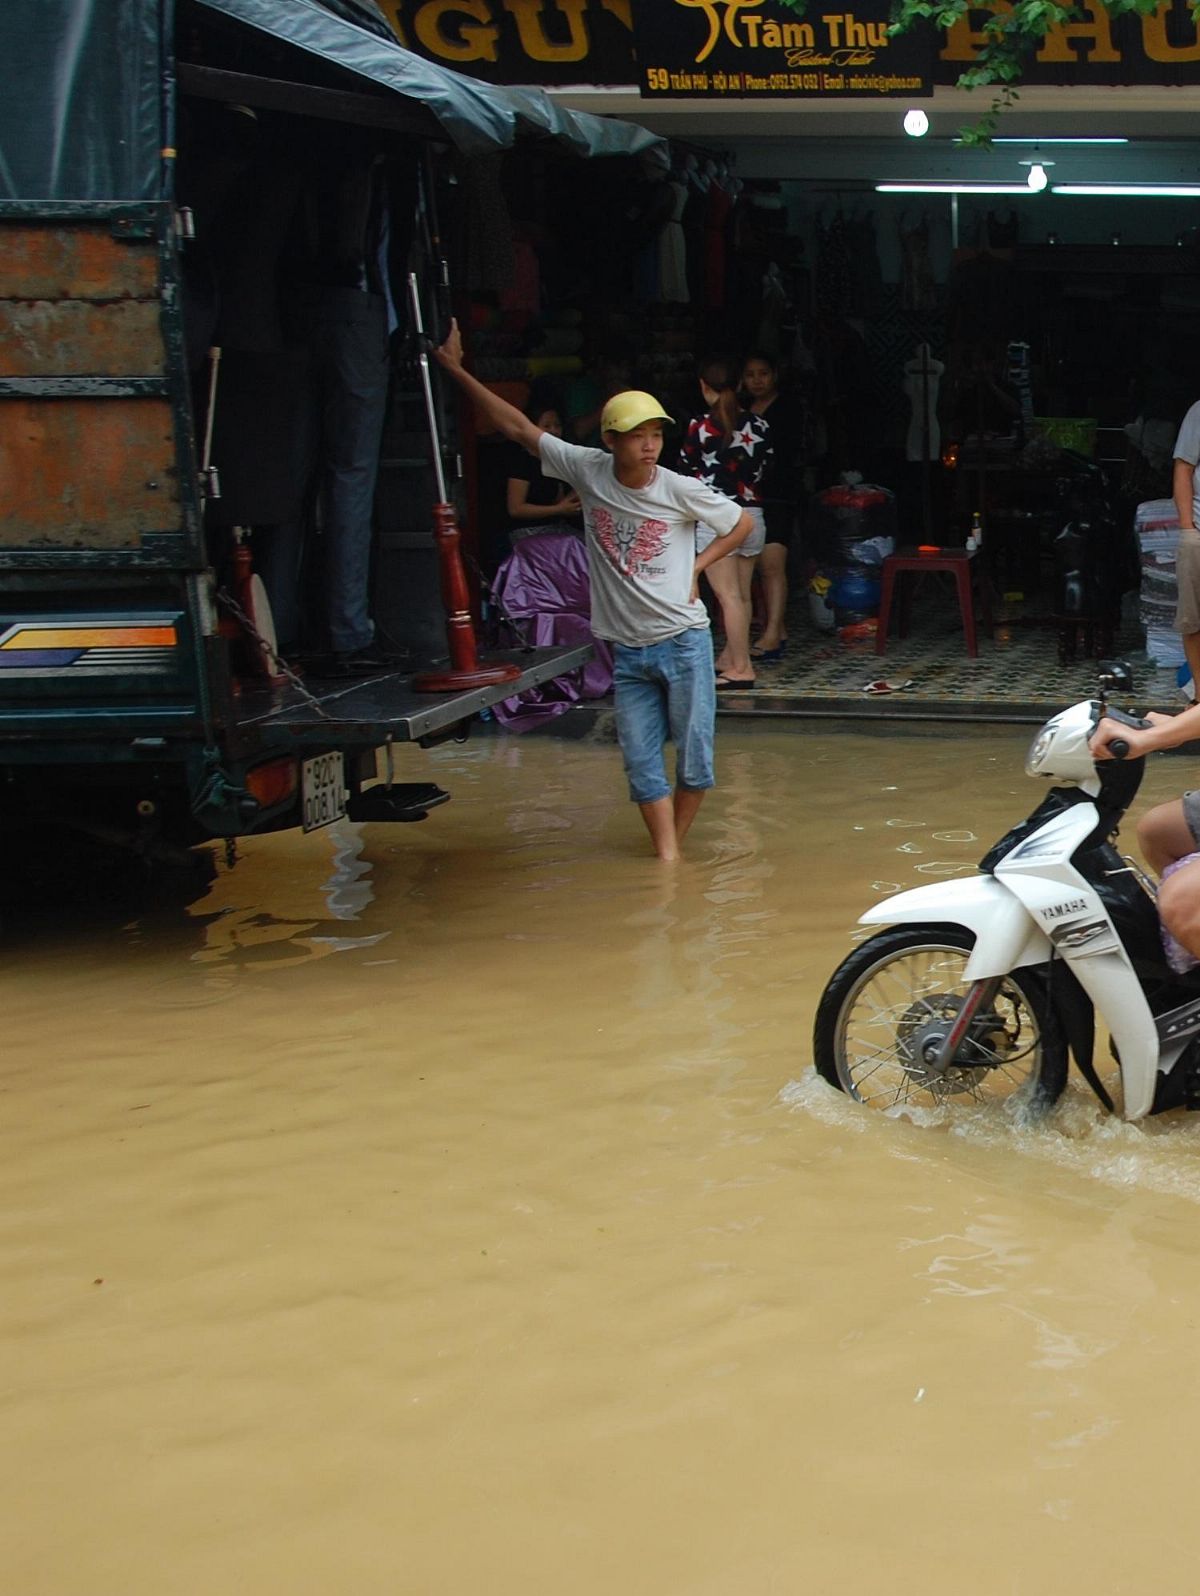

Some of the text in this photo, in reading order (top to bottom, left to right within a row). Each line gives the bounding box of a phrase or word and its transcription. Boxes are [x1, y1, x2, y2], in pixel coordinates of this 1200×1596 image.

[741, 16, 814, 48] Tâm
[646, 68, 669, 90] 59
[824, 74, 845, 89] Email
[313, 756, 336, 790] 92C
[1041, 899, 1089, 920] YAMAHA
